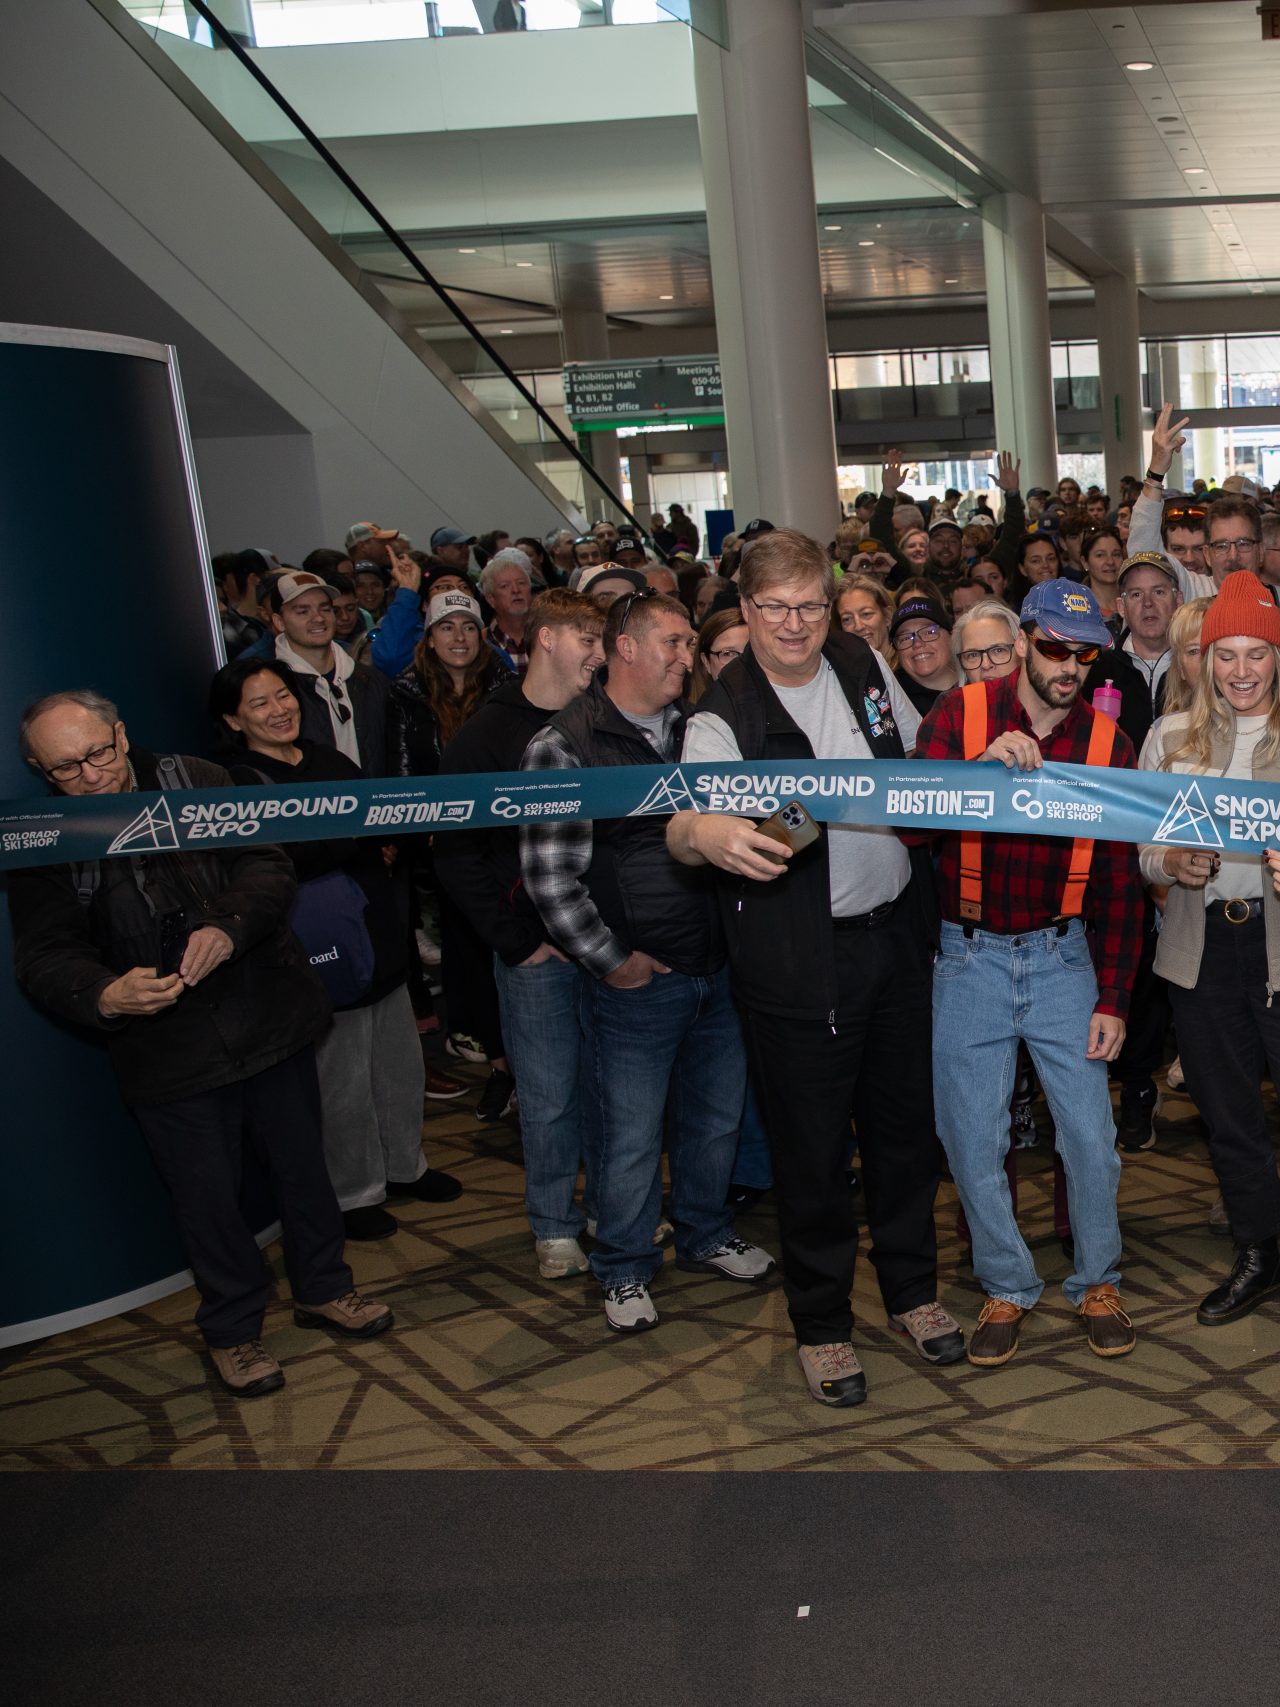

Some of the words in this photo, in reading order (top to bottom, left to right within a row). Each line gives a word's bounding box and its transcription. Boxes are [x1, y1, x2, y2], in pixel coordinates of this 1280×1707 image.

[572, 372, 615, 382] Exhibition
[617, 371, 633, 380] Hall
[635, 370, 642, 378] C
[677, 366, 712, 376] Meeting
[692, 376, 721, 385] 050-05
[573, 383, 614, 393] Exhibition
[616, 382, 636, 391] Halls
[576, 405, 613, 414] Executive
[616, 403, 640, 412] Office
[695, 774, 876, 797] SNOWBOUND
[524, 800, 581, 810] COLORADO
[708, 793, 780, 813] EXPO
[1046, 801, 1103, 813] COLORADO
[179, 796, 358, 823] SNOWBOUND
[523, 808, 541, 816] SKI
[544, 807, 576, 815] SHOP
[1046, 809, 1065, 818] SKI
[1067, 810, 1098, 822] SHOP
[2, 830, 60, 841] COLORADO
[187, 820, 260, 839] EXPO
[5, 840, 20, 851] SKI
[23, 838, 53, 849] SHOP
[309, 946, 340, 965] oard
